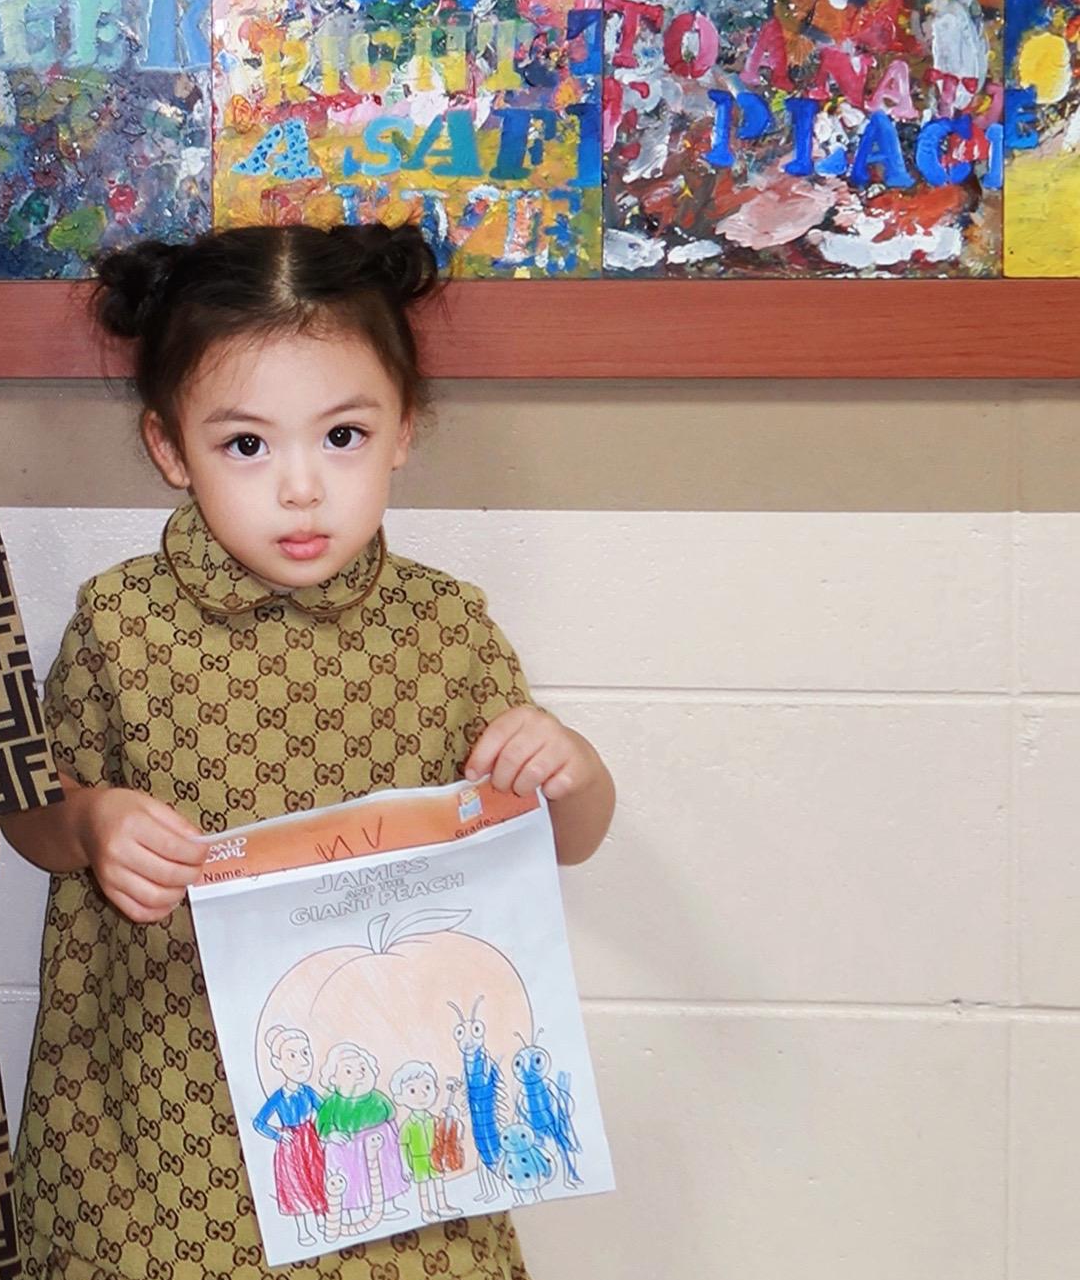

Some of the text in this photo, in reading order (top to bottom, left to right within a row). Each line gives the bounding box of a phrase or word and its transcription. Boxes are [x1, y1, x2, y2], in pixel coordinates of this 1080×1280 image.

[231, 116, 323, 180] A
[203, 866, 248, 884] Name:
[288, 871, 466, 927] GIANT PEACH
[313, 855, 430, 895] JAMES
